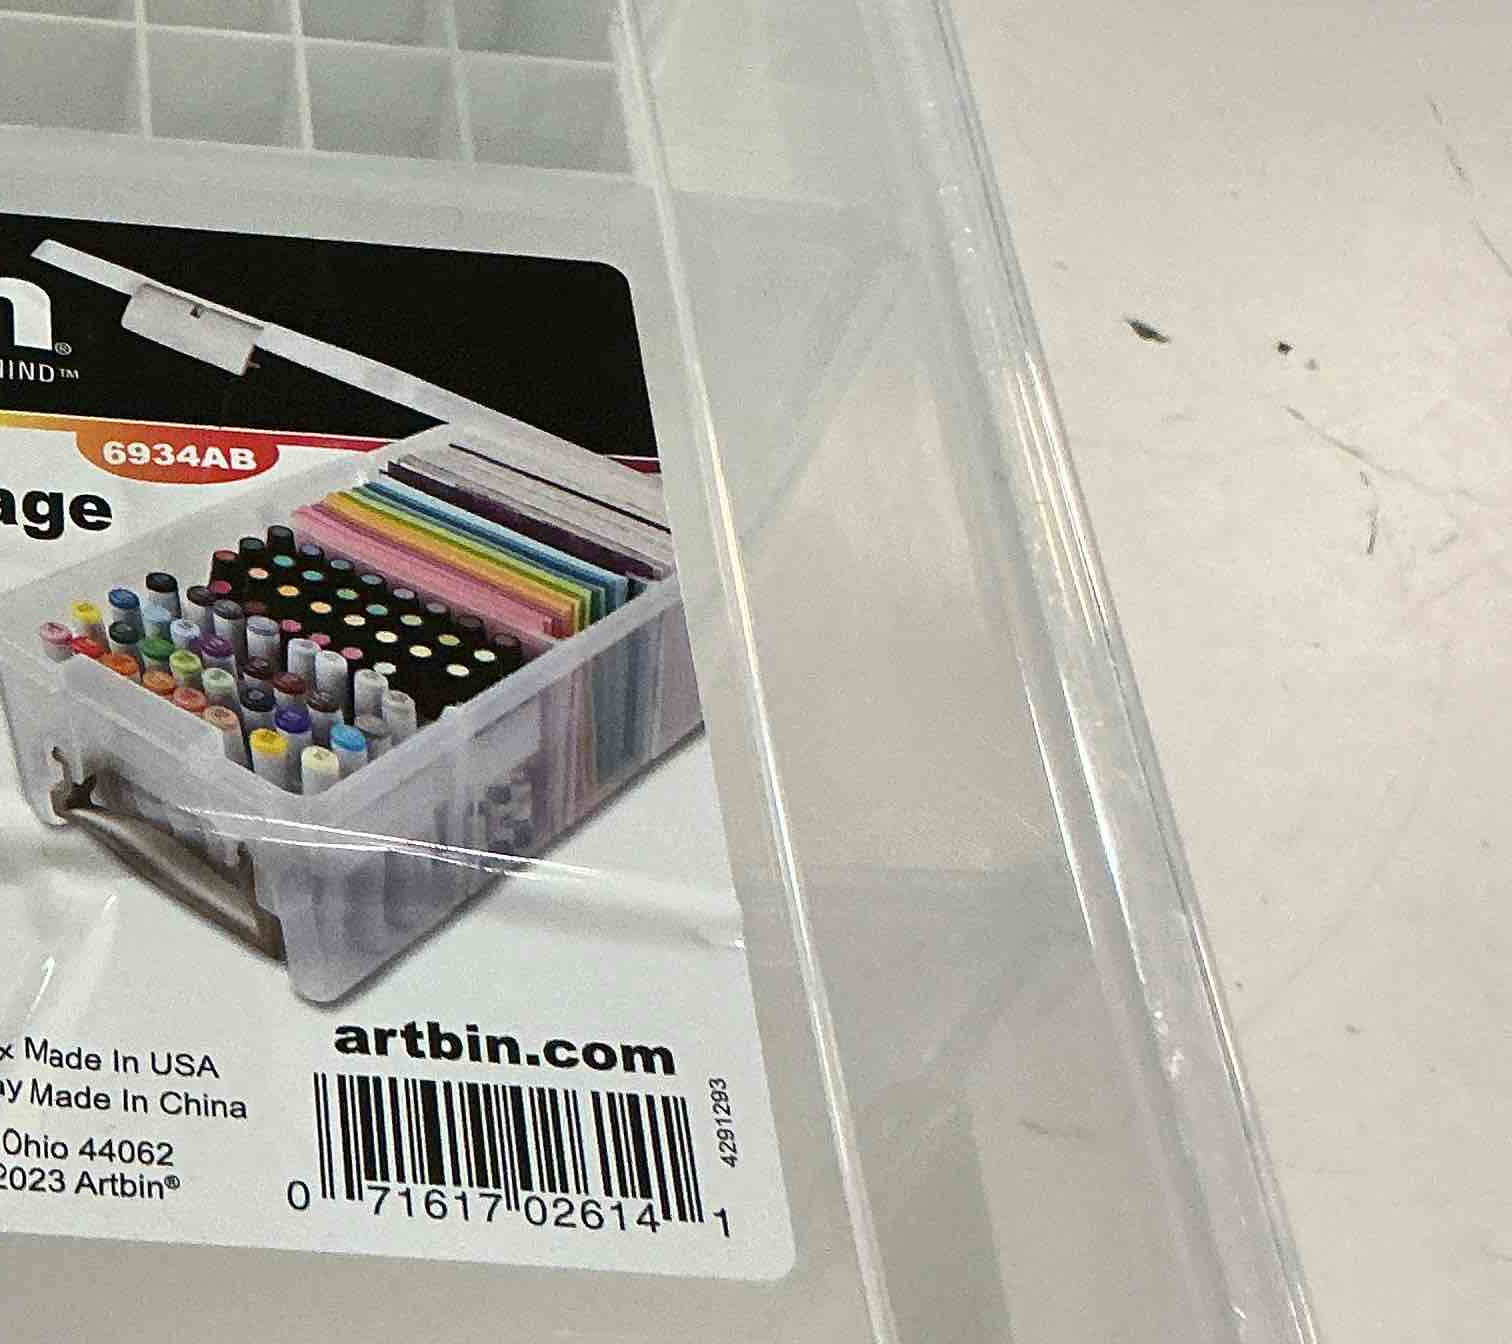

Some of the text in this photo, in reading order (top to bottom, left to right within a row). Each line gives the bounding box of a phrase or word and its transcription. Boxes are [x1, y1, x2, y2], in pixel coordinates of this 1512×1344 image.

[103, 440, 257, 471] 6934AB
[25, 1036, 102, 1072] Made
[113, 1050, 138, 1075] In
[151, 1052, 220, 1079] USA
[333, 1020, 676, 1076] artbin.com
[31, 1078, 111, 1111] Made
[123, 1089, 149, 1114] In
[160, 1091, 248, 1121] China
[709, 1077, 738, 1168] 4291293
[3, 1128, 68, 1160] Ohio
[79, 1137, 174, 1167] 44062
